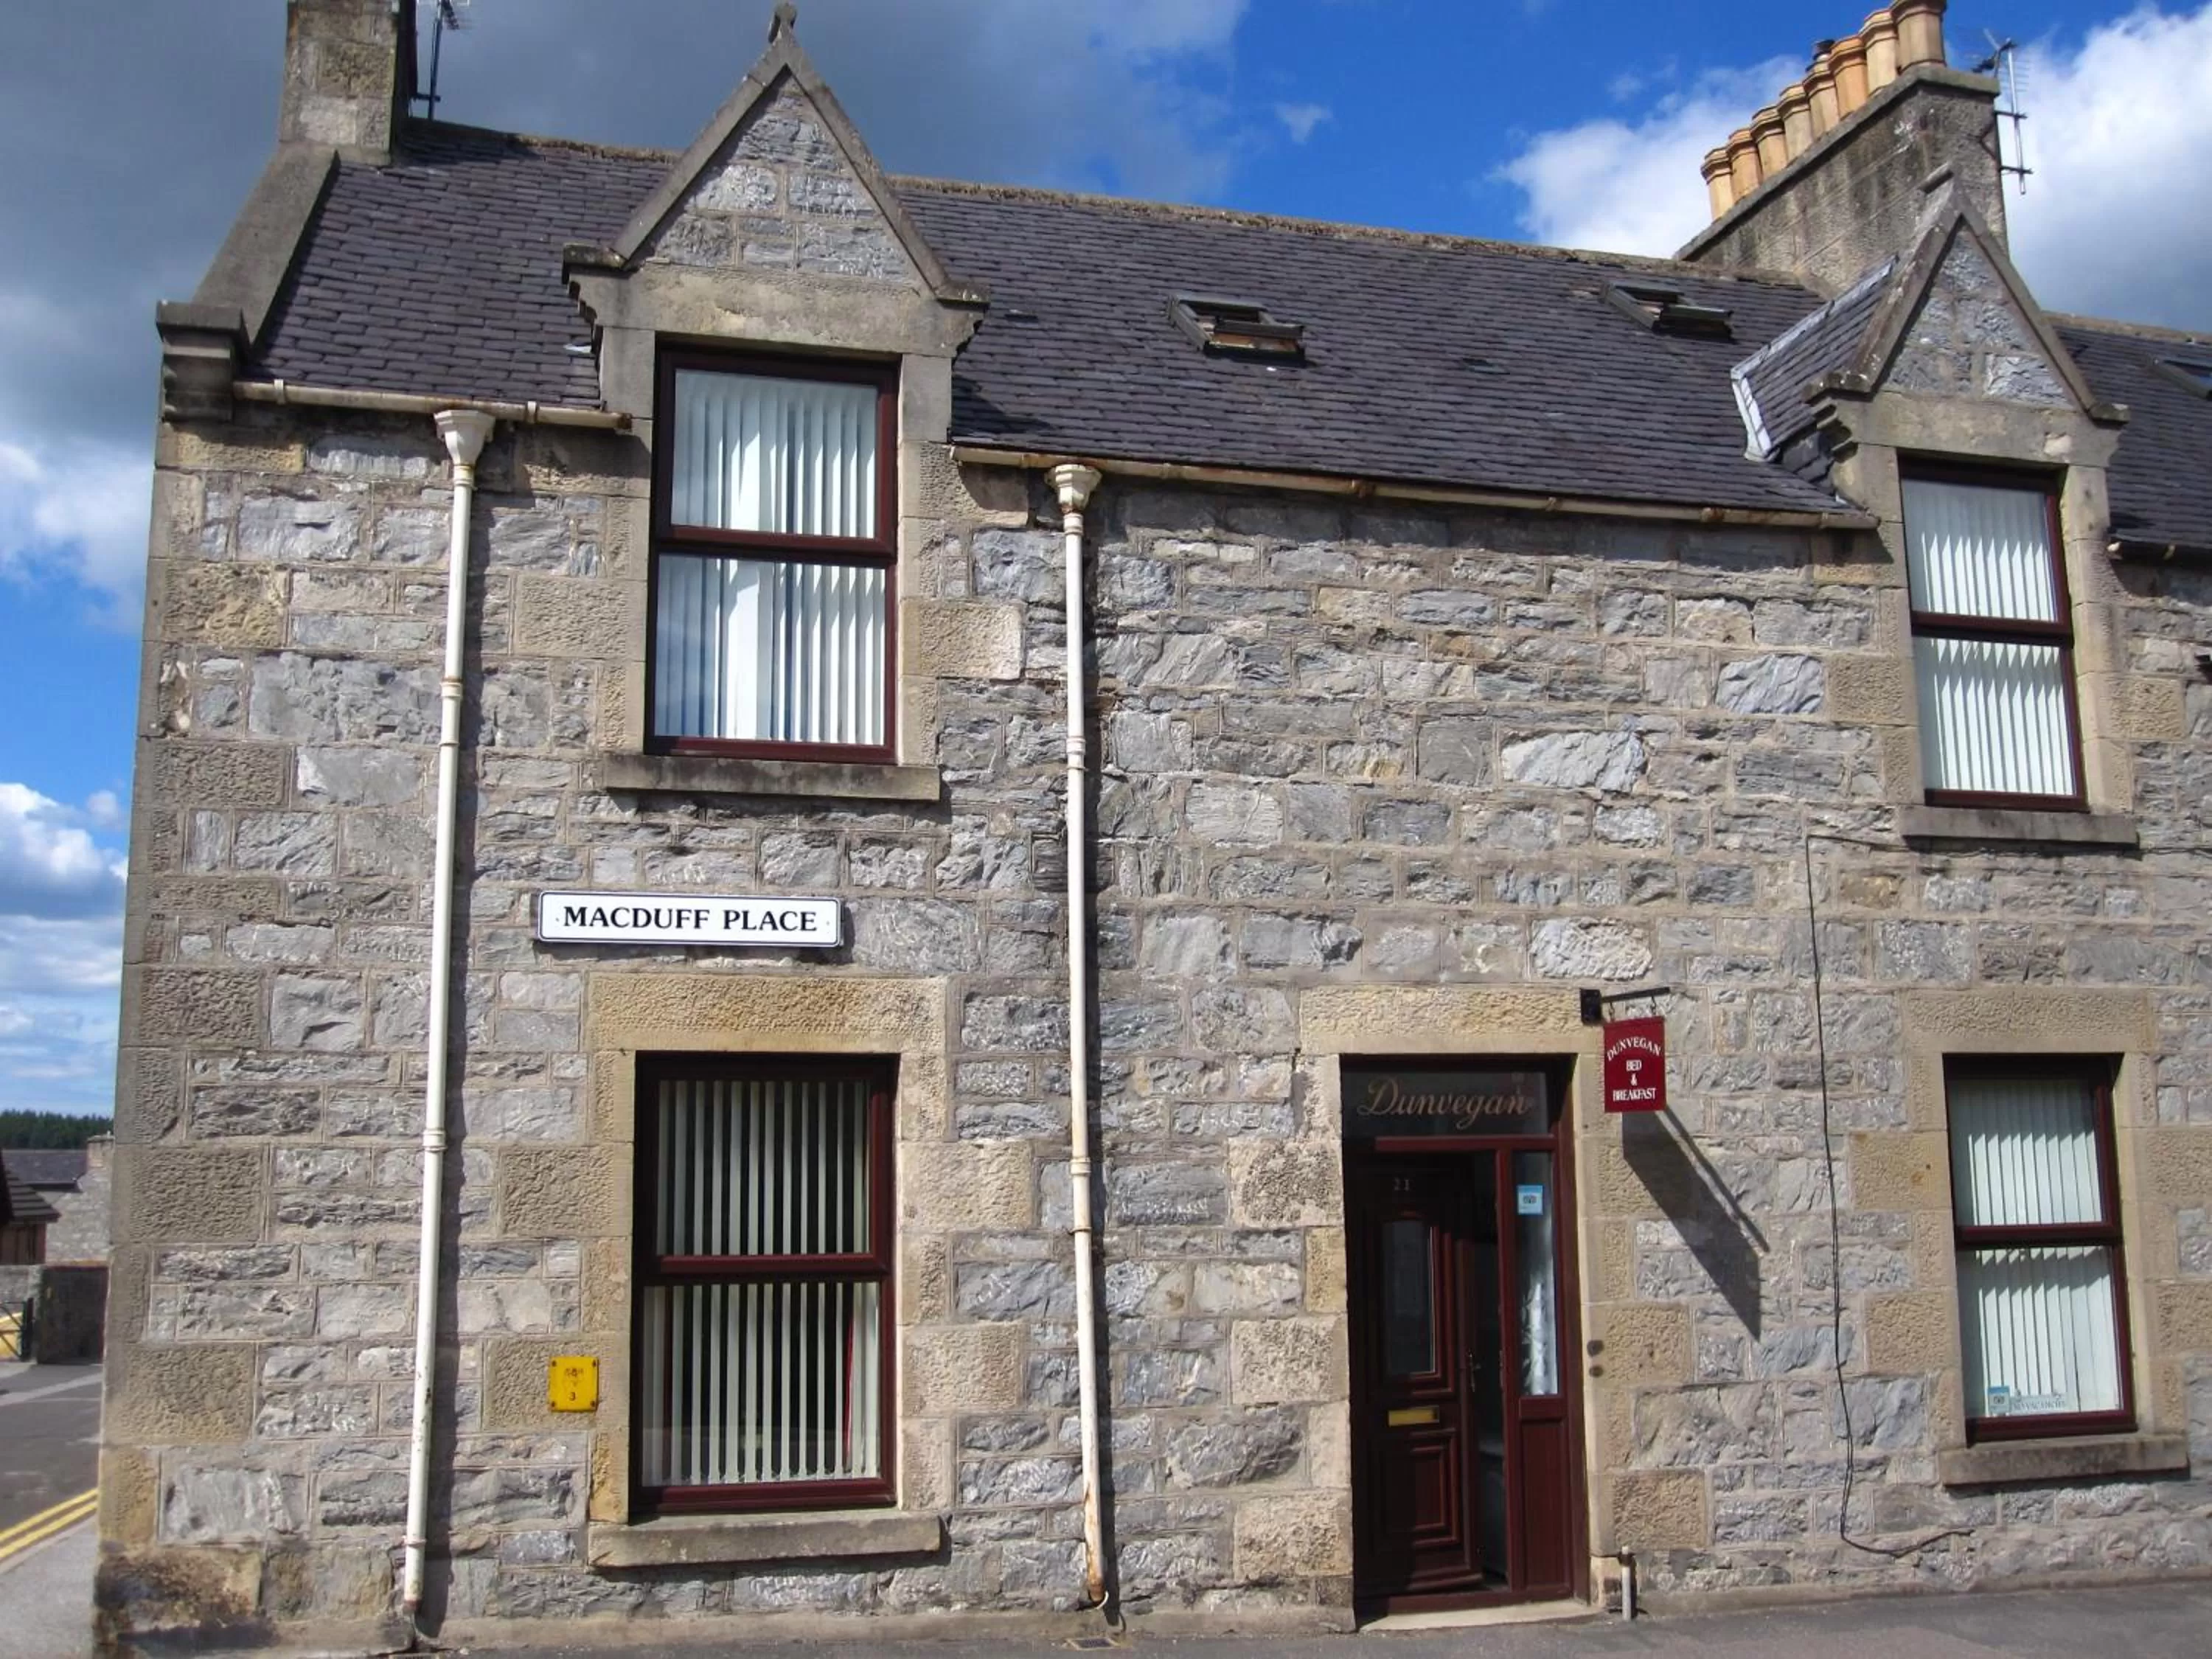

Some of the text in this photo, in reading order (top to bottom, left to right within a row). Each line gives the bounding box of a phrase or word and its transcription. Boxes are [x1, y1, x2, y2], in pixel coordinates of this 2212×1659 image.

[563, 906, 817, 931] MACDUFF PLACE
[1607, 1037, 1660, 1061] DUNVEGAN
[1357, 1077, 1528, 1130] Dunvegan
[1613, 1088, 1656, 1102] BREAKFAST
